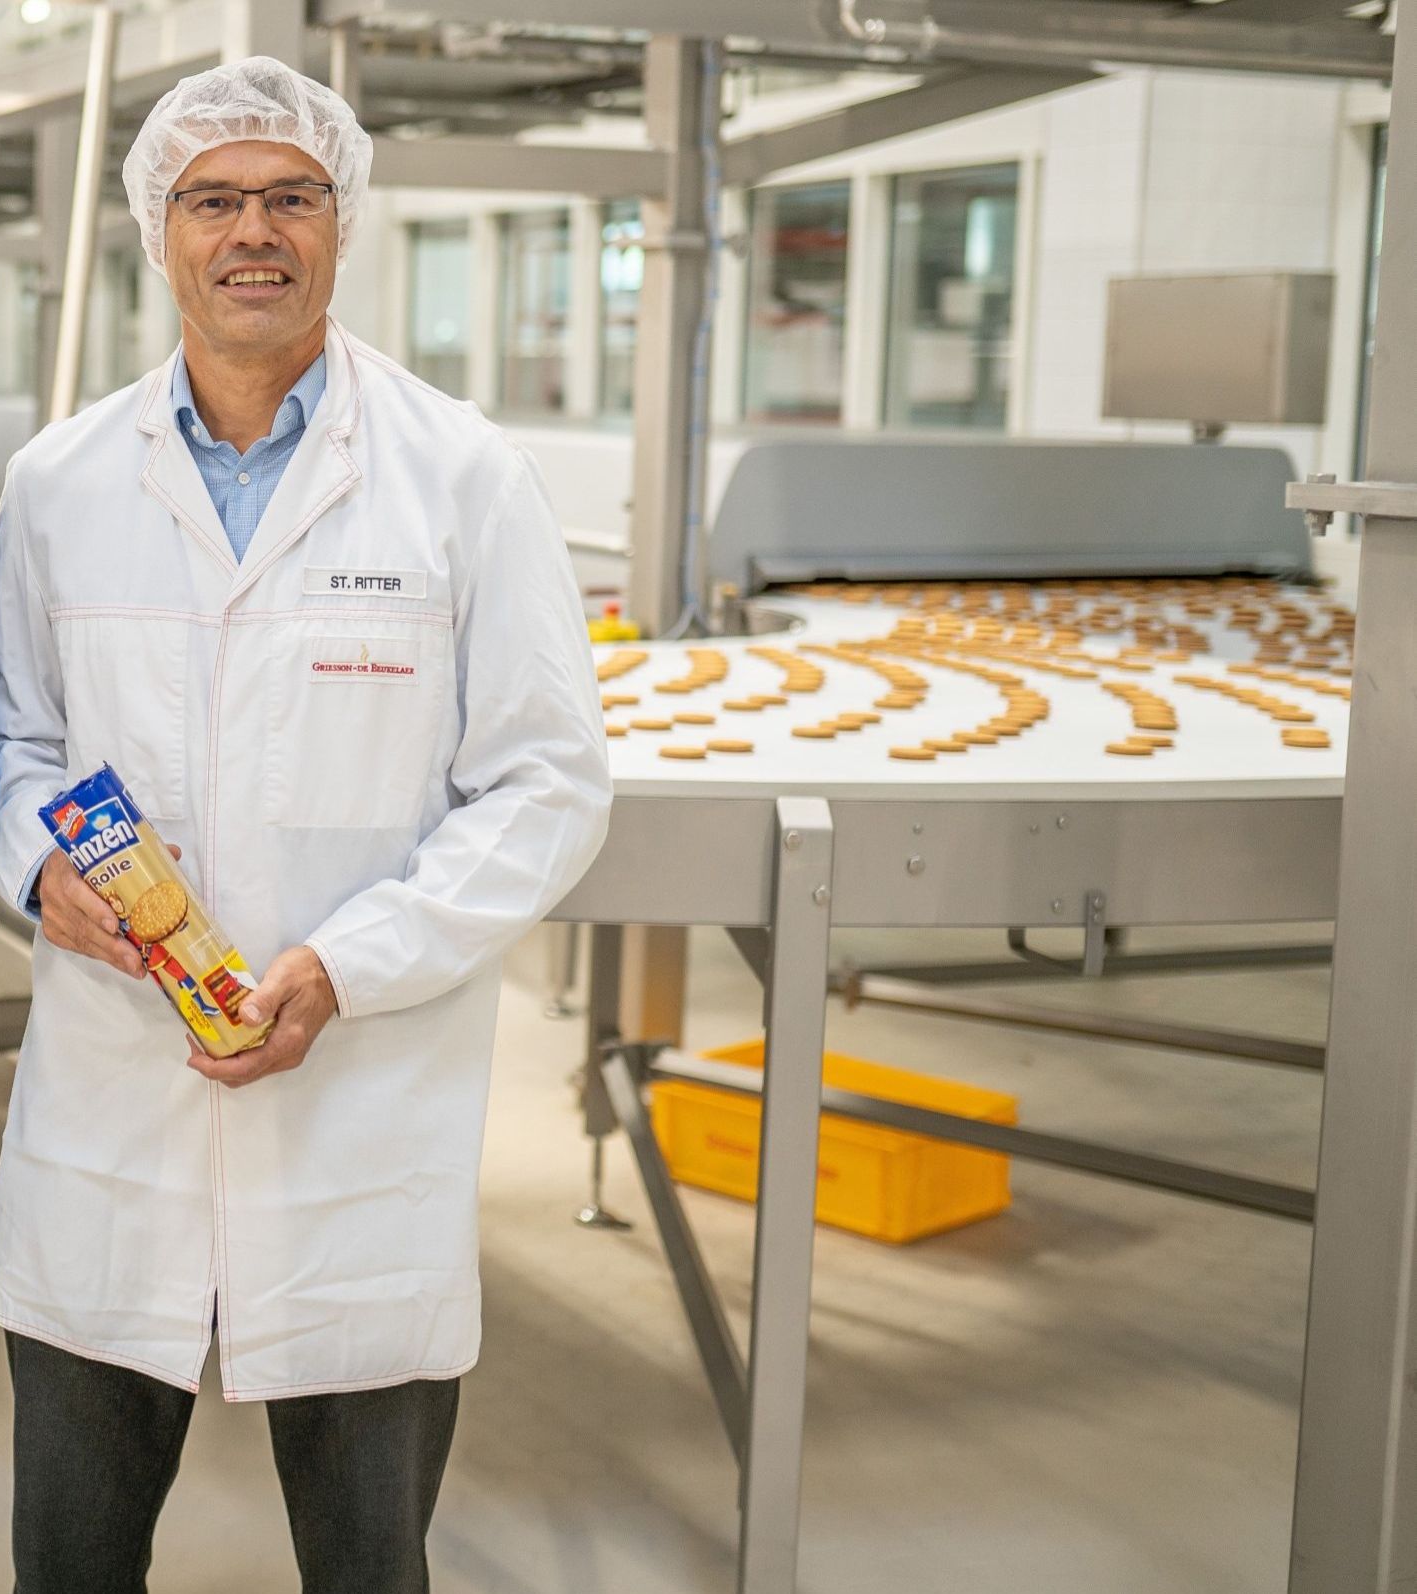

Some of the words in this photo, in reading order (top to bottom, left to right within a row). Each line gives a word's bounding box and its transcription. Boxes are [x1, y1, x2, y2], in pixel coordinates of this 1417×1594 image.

[330, 575, 351, 589] ST.
[355, 576, 402, 591] RITTER
[69, 819, 135, 871] rinzen
[89, 859, 133, 891] Rolle
